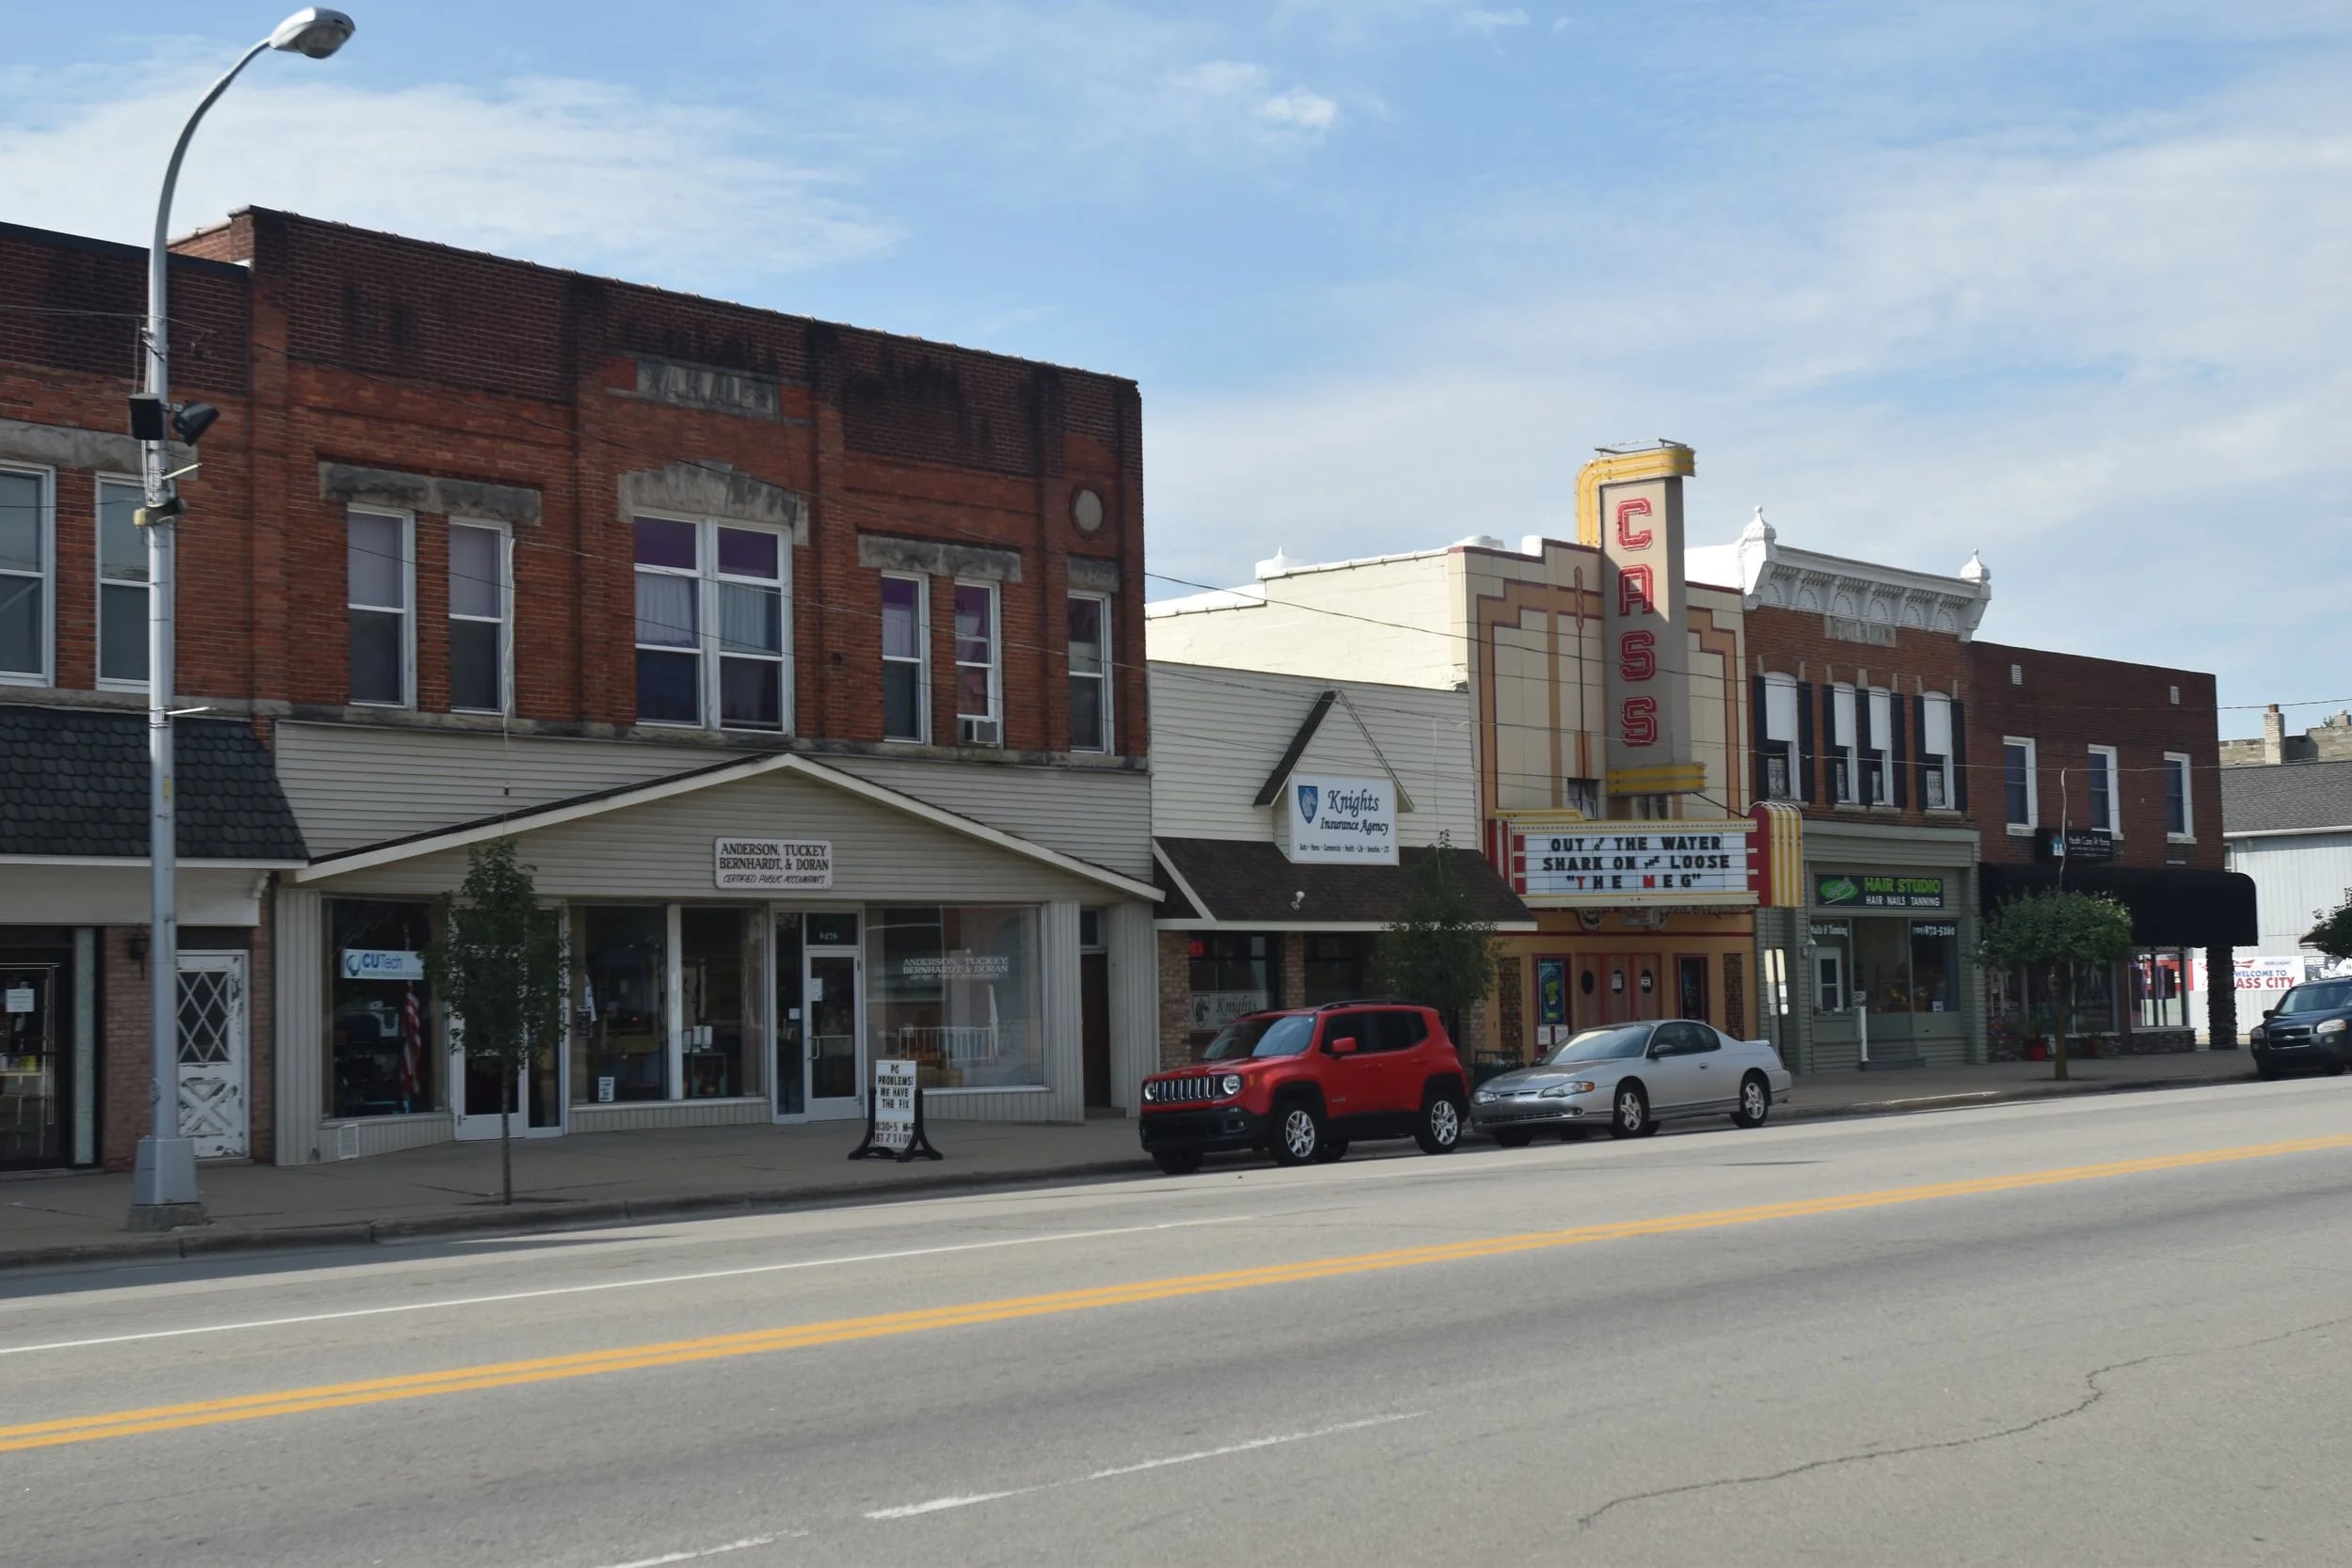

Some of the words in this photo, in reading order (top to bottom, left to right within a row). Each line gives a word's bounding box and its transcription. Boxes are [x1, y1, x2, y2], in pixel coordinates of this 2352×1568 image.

[1615, 497, 1658, 748] CASS
[1327, 788, 1380, 817] Knights
[1320, 817, 1359, 831] Insurance
[1359, 819, 1390, 836] Agency
[721, 843, 780, 856] ANDERSON,
[783, 845, 827, 856] TUCKEY
[1551, 838, 1584, 852] OUT
[1614, 836, 1648, 851] THE
[1661, 836, 1722, 850] WATER
[719, 858, 782, 871] BERNHARDT,
[786, 859, 792, 870] &
[796, 859, 829, 870] DORAN
[1543, 857, 1603, 871] SHARK
[1613, 856, 1636, 870] ON
[1671, 855, 1730, 869] LOOSE
[723, 875, 755, 883] CERTIFIED
[758, 875, 782, 884] PUBLIC
[784, 875, 825, 884] ACCOUNTANTS
[1865, 877, 1894, 892] HAIR
[1897, 879, 1942, 894] STUDIO
[1866, 895, 1883, 905] HAIR
[1886, 896, 1906, 906] NAILS
[1911, 896, 1941, 907] TANNING
[975, 965, 1009, 974] DORAN
[2265, 977, 2295, 989] CITY
[1216, 996, 1258, 1017] Knights
[881, 1087, 889, 1098] WE
[893, 1088, 909, 1098] HAVE
[882, 1099, 894, 1109] THE
[899, 1100, 910, 1109] FIX
